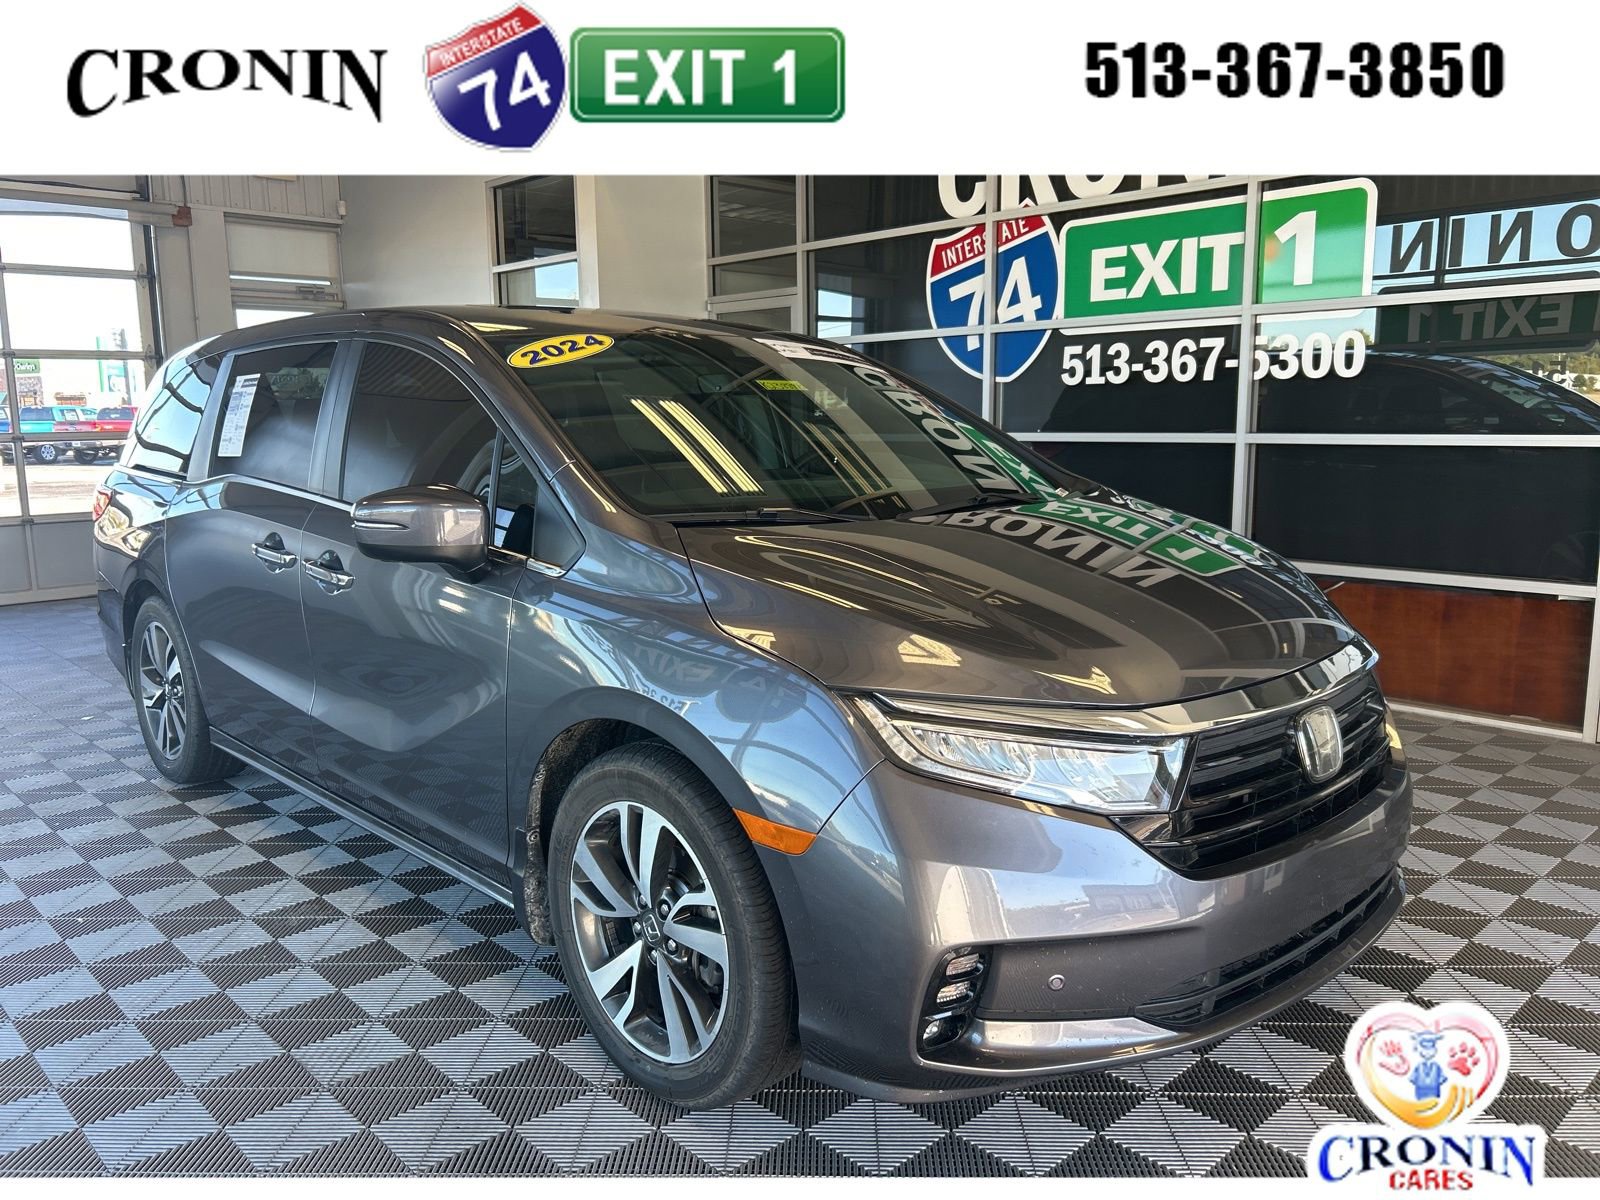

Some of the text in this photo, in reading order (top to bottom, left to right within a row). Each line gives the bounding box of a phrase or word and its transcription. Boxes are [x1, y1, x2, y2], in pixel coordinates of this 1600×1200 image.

[1090, 210, 1317, 303] EXIT 1
[948, 255, 1043, 351] 74
[520, 335, 605, 365] 2024
[1060, 329, 1366, 387] 513-367-5300
